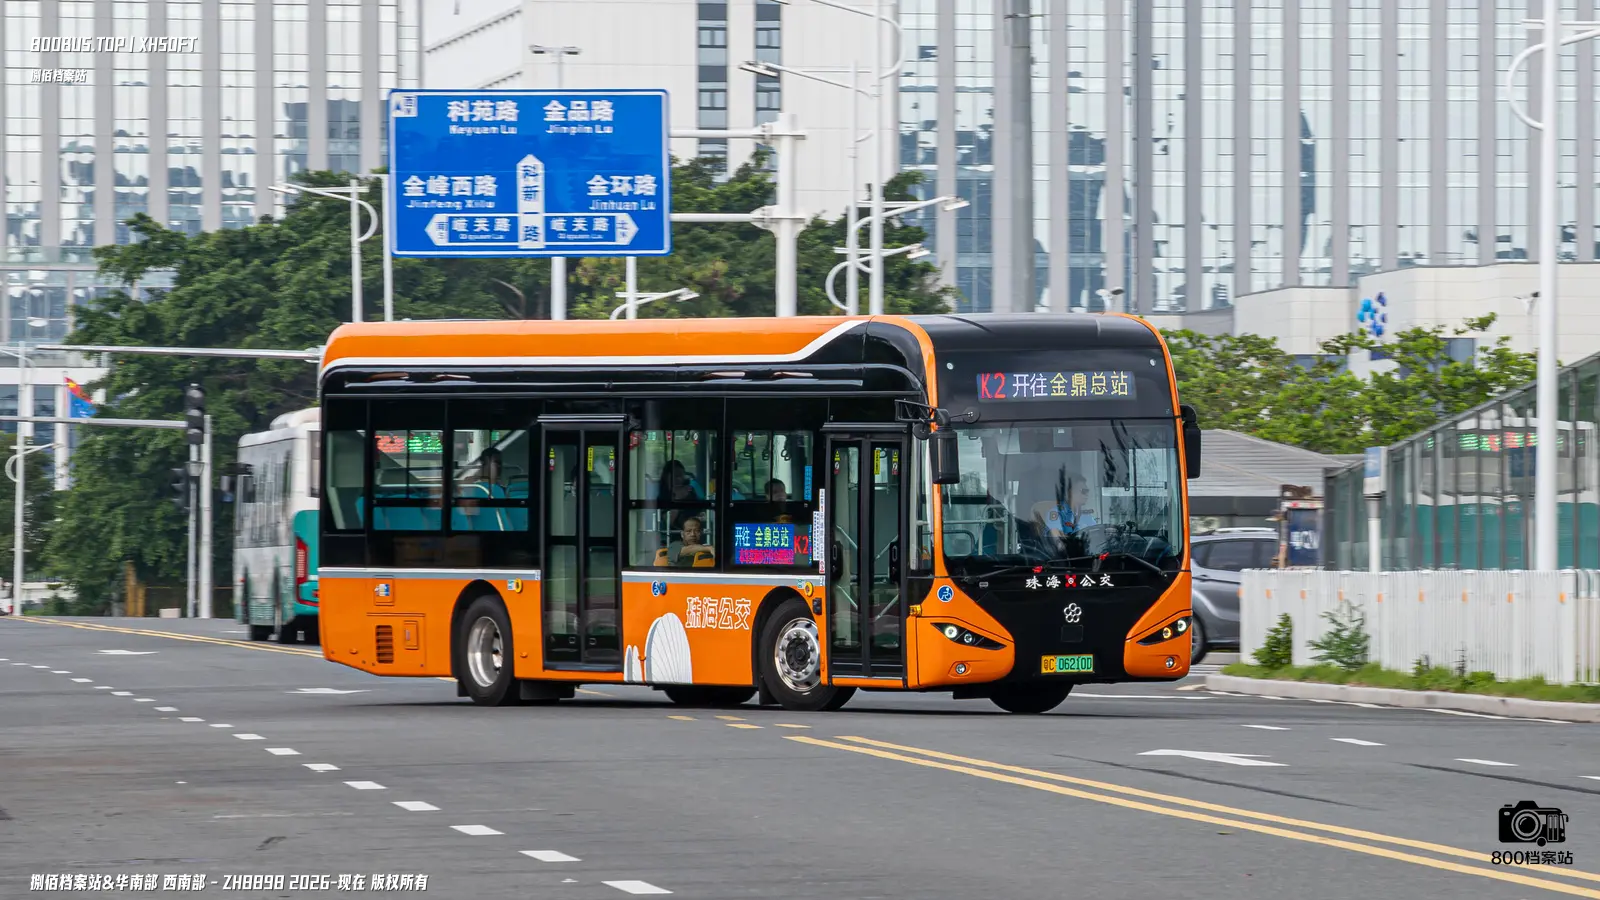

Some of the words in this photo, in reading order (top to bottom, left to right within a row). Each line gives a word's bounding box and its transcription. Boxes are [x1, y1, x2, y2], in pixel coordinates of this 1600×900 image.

[447, 100, 519, 121] 科苑路
[543, 100, 614, 121] 金品路
[500, 124, 518, 134] Lu
[595, 124, 613, 134] Lu
[402, 175, 498, 196] 金峰西路
[586, 174, 657, 196] 金环路
[640, 200, 656, 210] Lu
[981, 372, 1006, 398] K2
[794, 535, 809, 554] K2
[685, 597, 751, 630] 珠海公交
